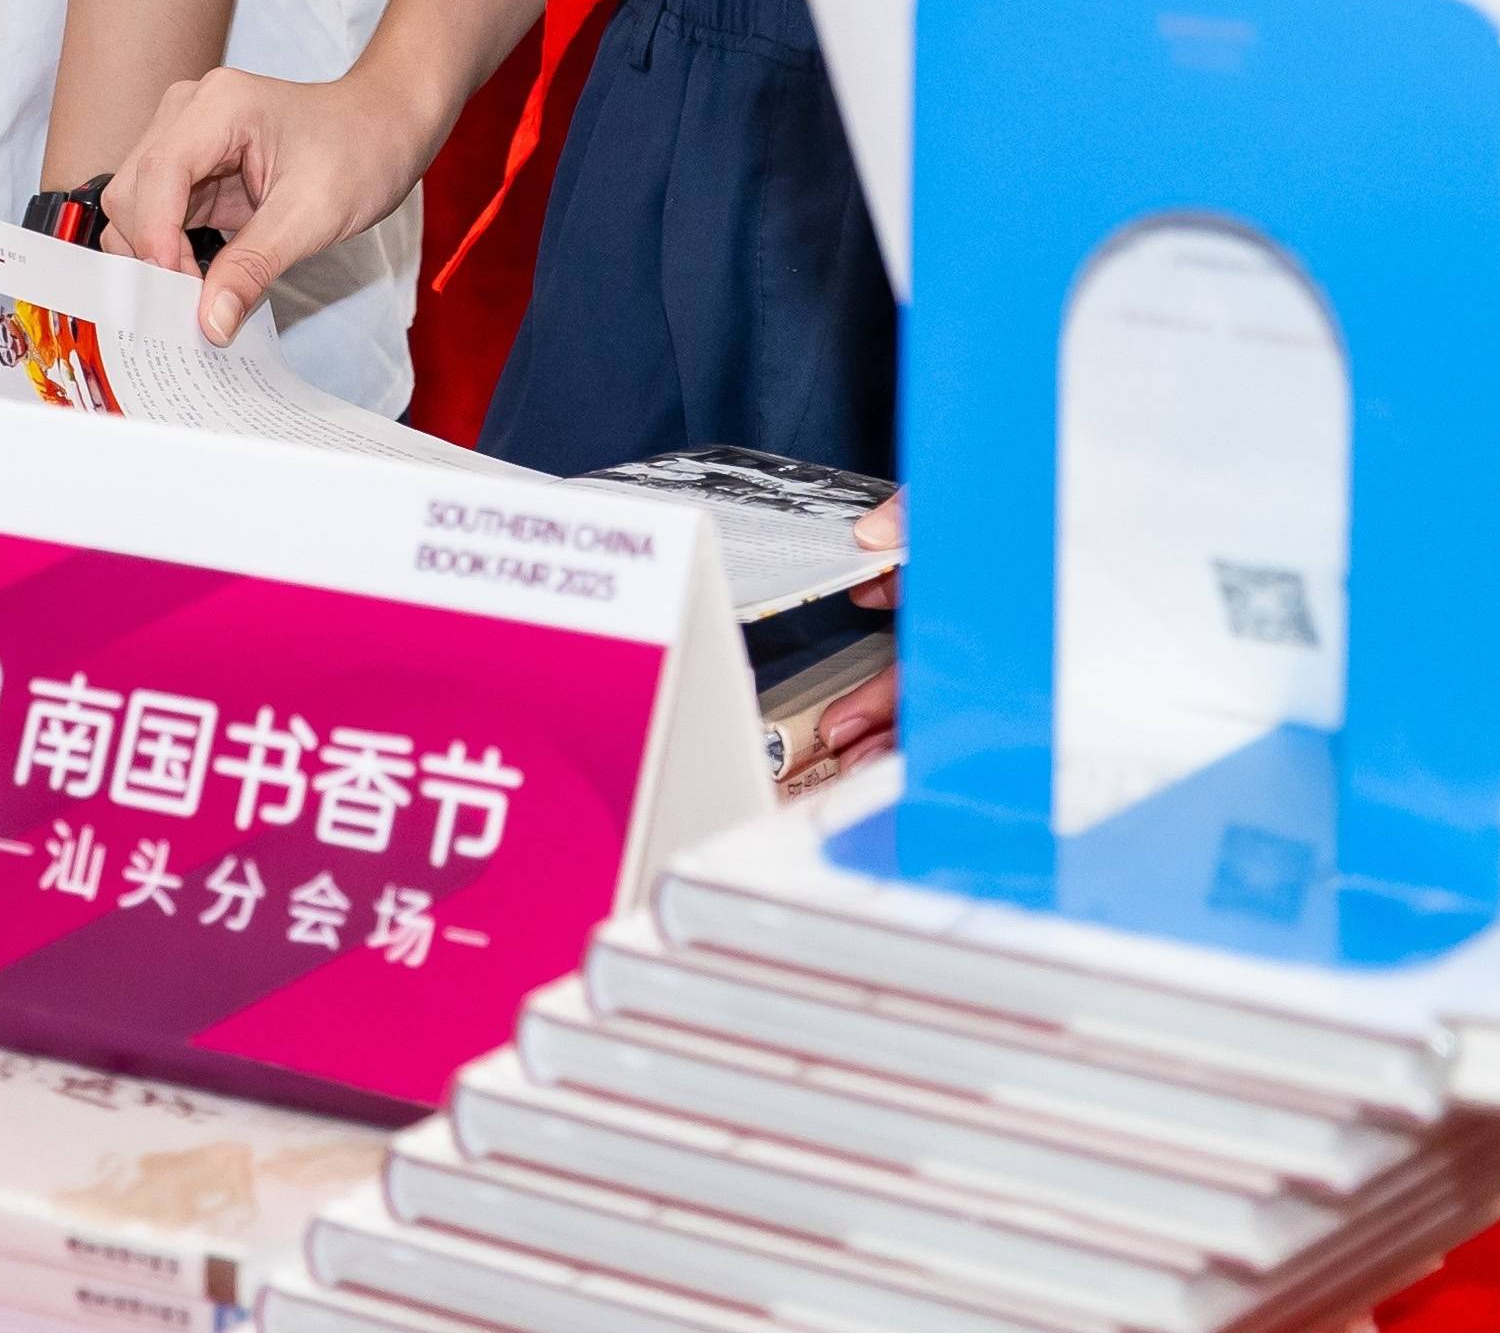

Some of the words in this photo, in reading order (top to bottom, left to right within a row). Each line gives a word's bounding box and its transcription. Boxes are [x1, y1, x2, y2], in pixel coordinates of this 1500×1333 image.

[424, 498, 570, 555] SOUTHERN
[576, 520, 659, 563] CHINA
[413, 541, 488, 581] BOOK
[494, 552, 556, 591] FAIR
[556, 565, 618, 603] 2025
[12, 670, 526, 870] 南国书香节
